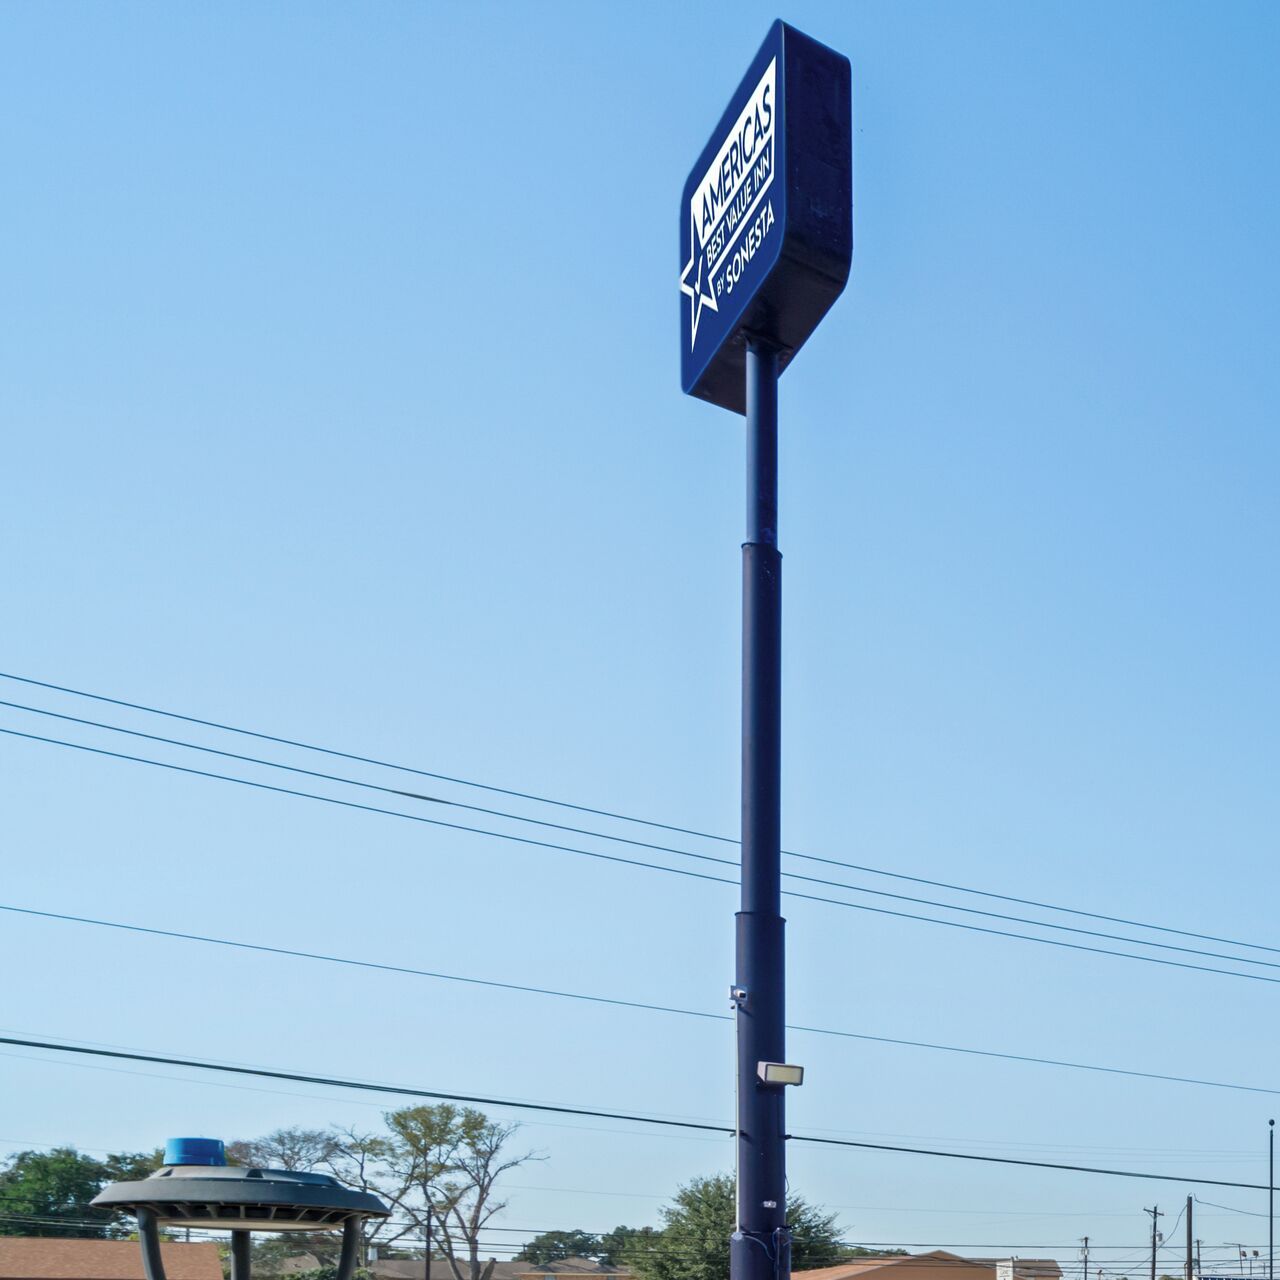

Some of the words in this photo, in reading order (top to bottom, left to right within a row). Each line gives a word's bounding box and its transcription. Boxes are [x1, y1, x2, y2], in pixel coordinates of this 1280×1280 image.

[702, 83, 772, 240] AMERICAS
[706, 221, 725, 269] BEST
[726, 177, 752, 233] VALUE
[754, 147, 770, 191] INN
[717, 274, 725, 297] BY
[727, 199, 775, 294] SONESTA
